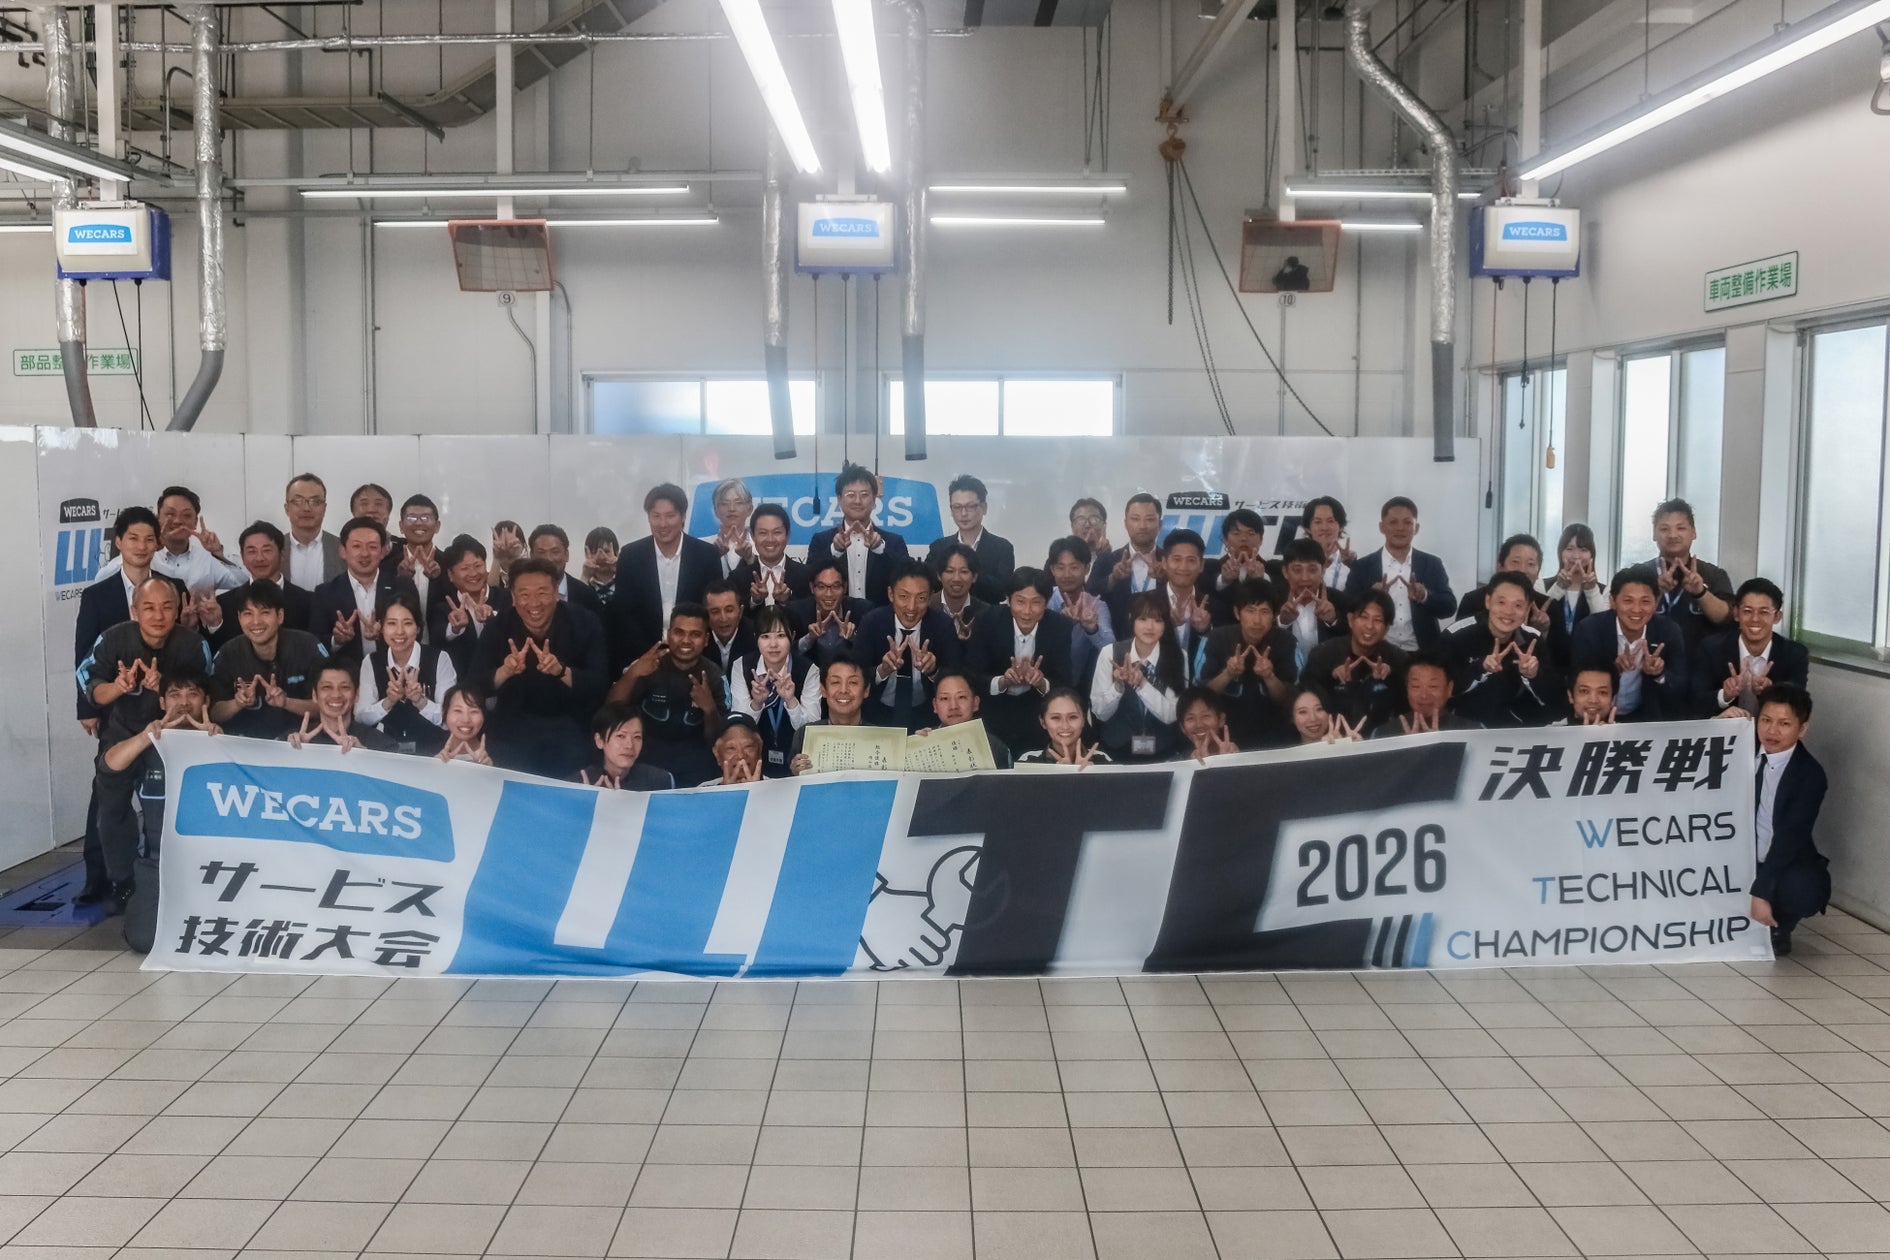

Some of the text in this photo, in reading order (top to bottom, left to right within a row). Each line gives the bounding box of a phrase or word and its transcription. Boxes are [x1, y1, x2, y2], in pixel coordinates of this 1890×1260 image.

[74, 229, 126, 240] WECARS
[818, 223, 873, 233] WECARS
[1509, 226, 1561, 238] WECARS
[1709, 261, 1792, 302] 車両整備作業場
[19, 353, 132, 371] 部品整作業場
[63, 505, 97, 517] WECARS
[1172, 496, 1224, 506] WECARS
[1478, 735, 1737, 801] 決勝戦
[206, 782, 422, 840] WECARS
[1575, 811, 1736, 849] WECARS
[1296, 823, 1448, 909] 2026
[1531, 865, 1742, 906] TECHNICAL
[200, 861, 445, 918] サービス
[174, 915, 441, 969] 技術大会
[1446, 916, 1751, 960] CHAMPIONSHIP
